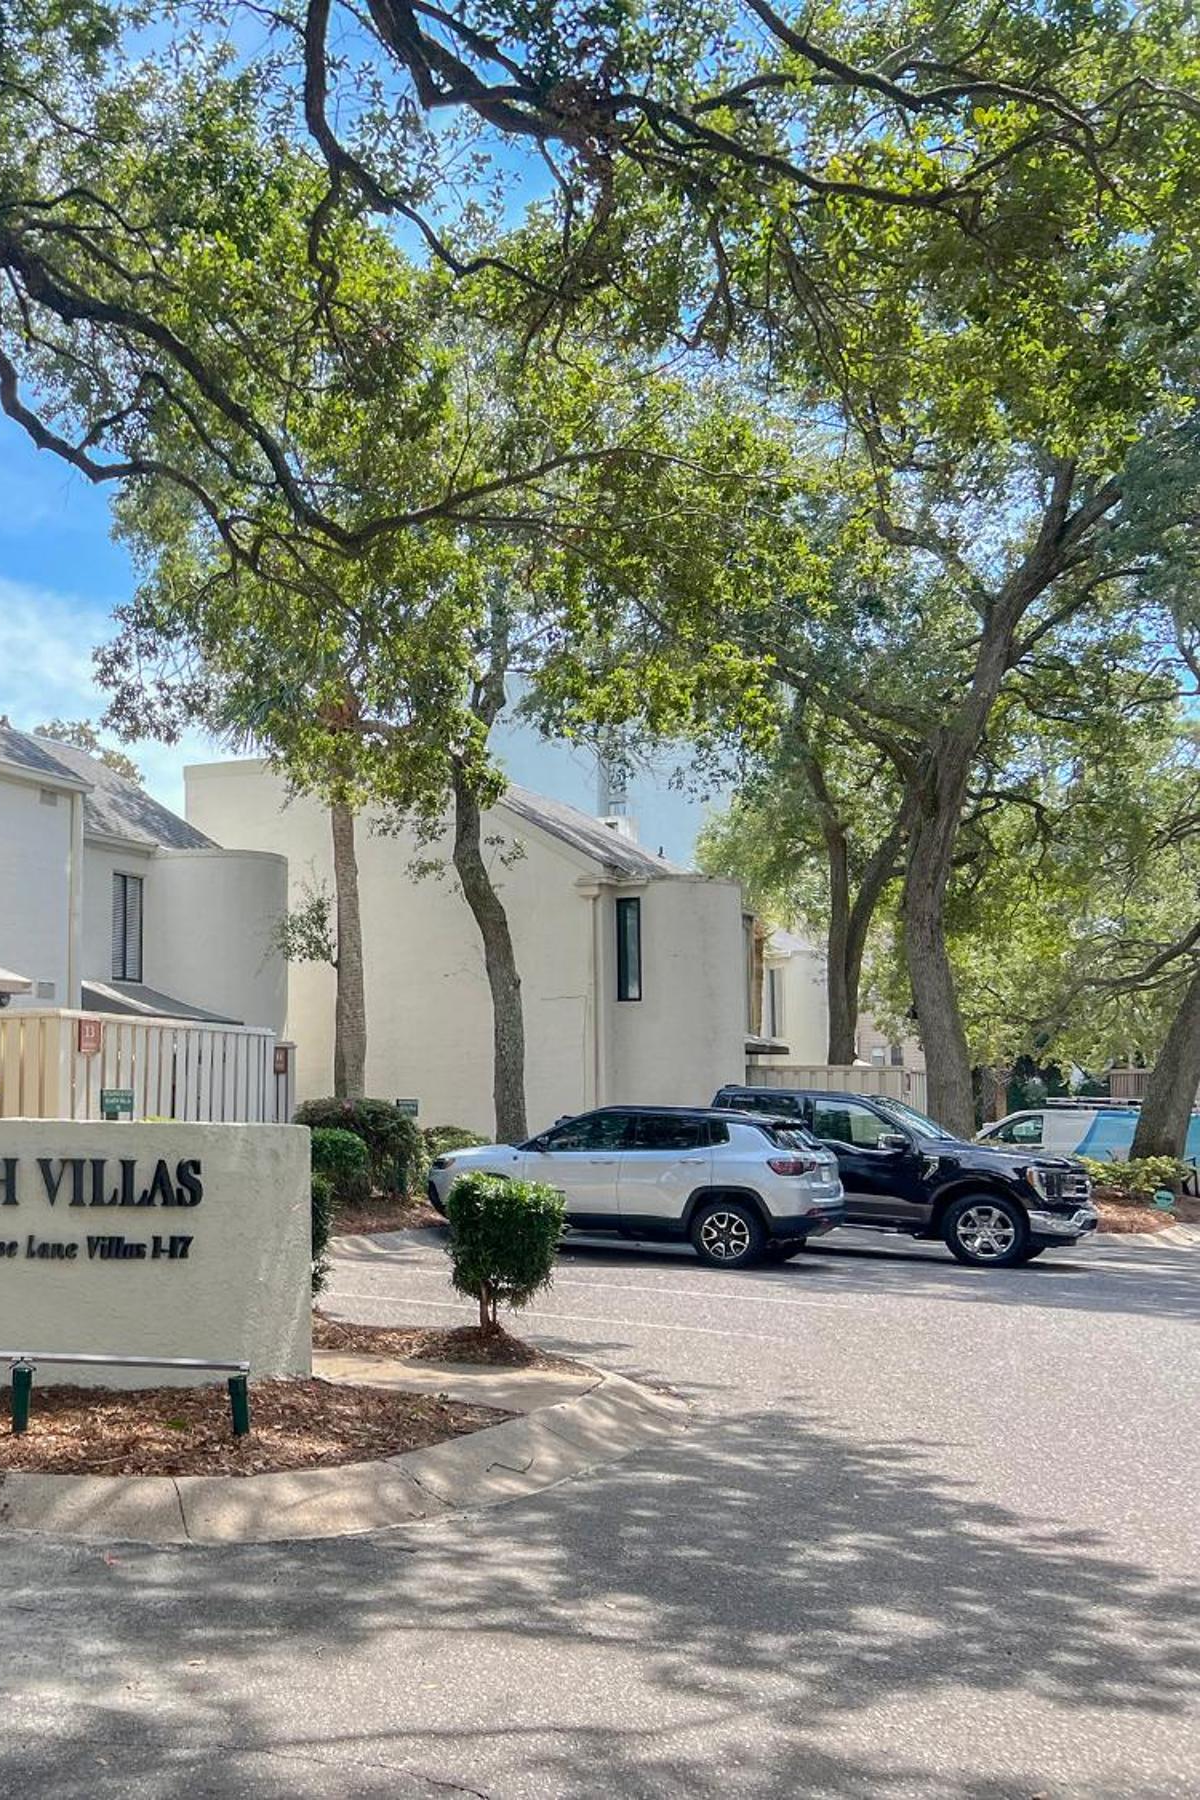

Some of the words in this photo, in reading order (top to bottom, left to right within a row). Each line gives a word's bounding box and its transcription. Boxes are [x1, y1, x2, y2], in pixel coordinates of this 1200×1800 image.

[36, 1158, 204, 1207] VILLAS
[26, 1235, 79, 1259] Lane
[87, 1236, 147, 1260] Villas
[152, 1236, 193, 1259] 1-17
